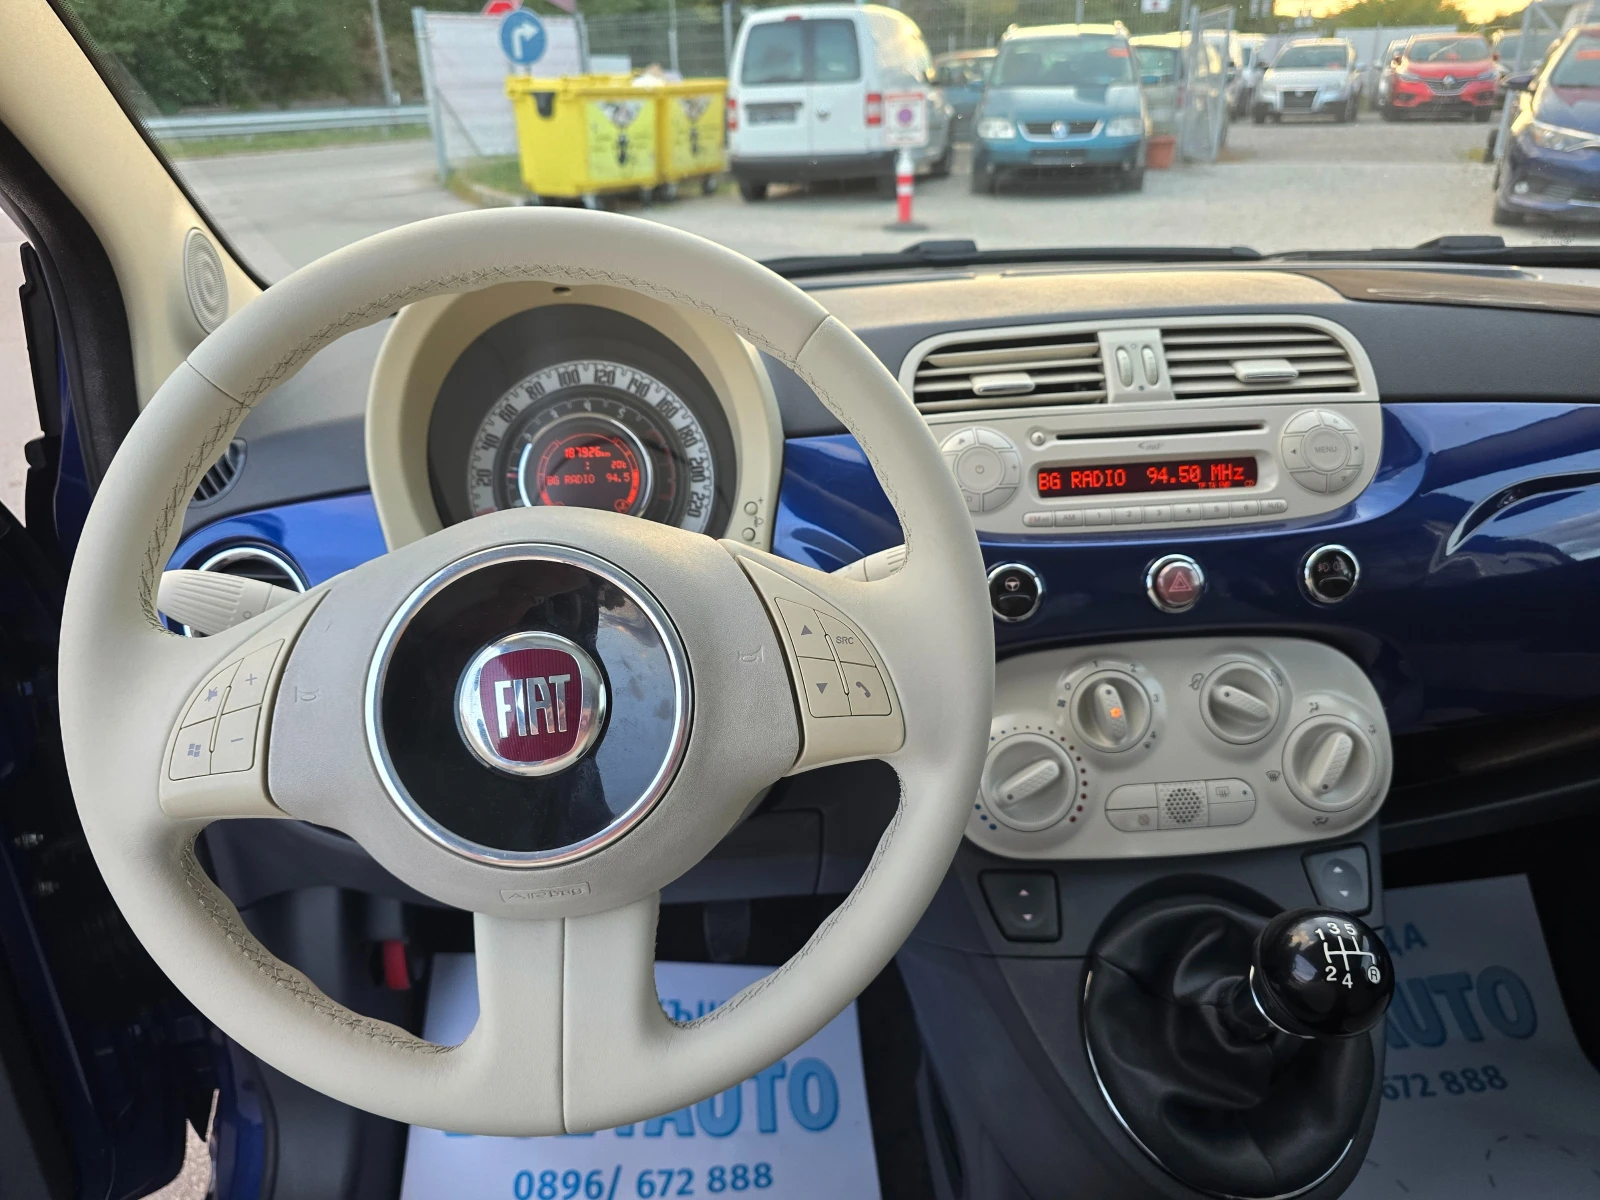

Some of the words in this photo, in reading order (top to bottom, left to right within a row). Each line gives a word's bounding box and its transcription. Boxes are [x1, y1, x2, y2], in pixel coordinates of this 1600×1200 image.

[558, 368, 580, 386] 100
[594, 369, 615, 385] 120
[526, 381, 545, 400] 80
[626, 377, 650, 398] 140
[499, 403, 519, 423] 60
[655, 396, 680, 420] 160
[482, 433, 500, 450] 40
[677, 425, 697, 449] 180
[1314, 446, 1338, 454] MENU
[476, 468, 493, 487] 20
[546, 474, 560, 486] BG
[564, 474, 595, 484] RADIO
[606, 472, 630, 482] 94.5
[689, 458, 706, 483] 200
[1038, 472, 1062, 490] BG
[1071, 469, 1126, 488] RADIO
[1146, 464, 1201, 484] 94.50
[1211, 463, 1245, 481] MHz
[687, 492, 706, 518] 220
[836, 636, 854, 644] SRC
[1130, 664, 1137, 672] 2
[495, 674, 571, 739] FIAT
[1315, 928, 1325, 940] 1
[1327, 922, 1341, 935] 3
[1344, 923, 1356, 936] 5
[1325, 965, 1337, 981] 2
[1342, 973, 1353, 989] 4
[1384, 1073, 1437, 1100] 672
[1439, 1064, 1508, 1095] 888
[513, 1164, 622, 1200] 0896/
[637, 1168, 695, 1199] 672
[707, 1161, 773, 1194] 888
